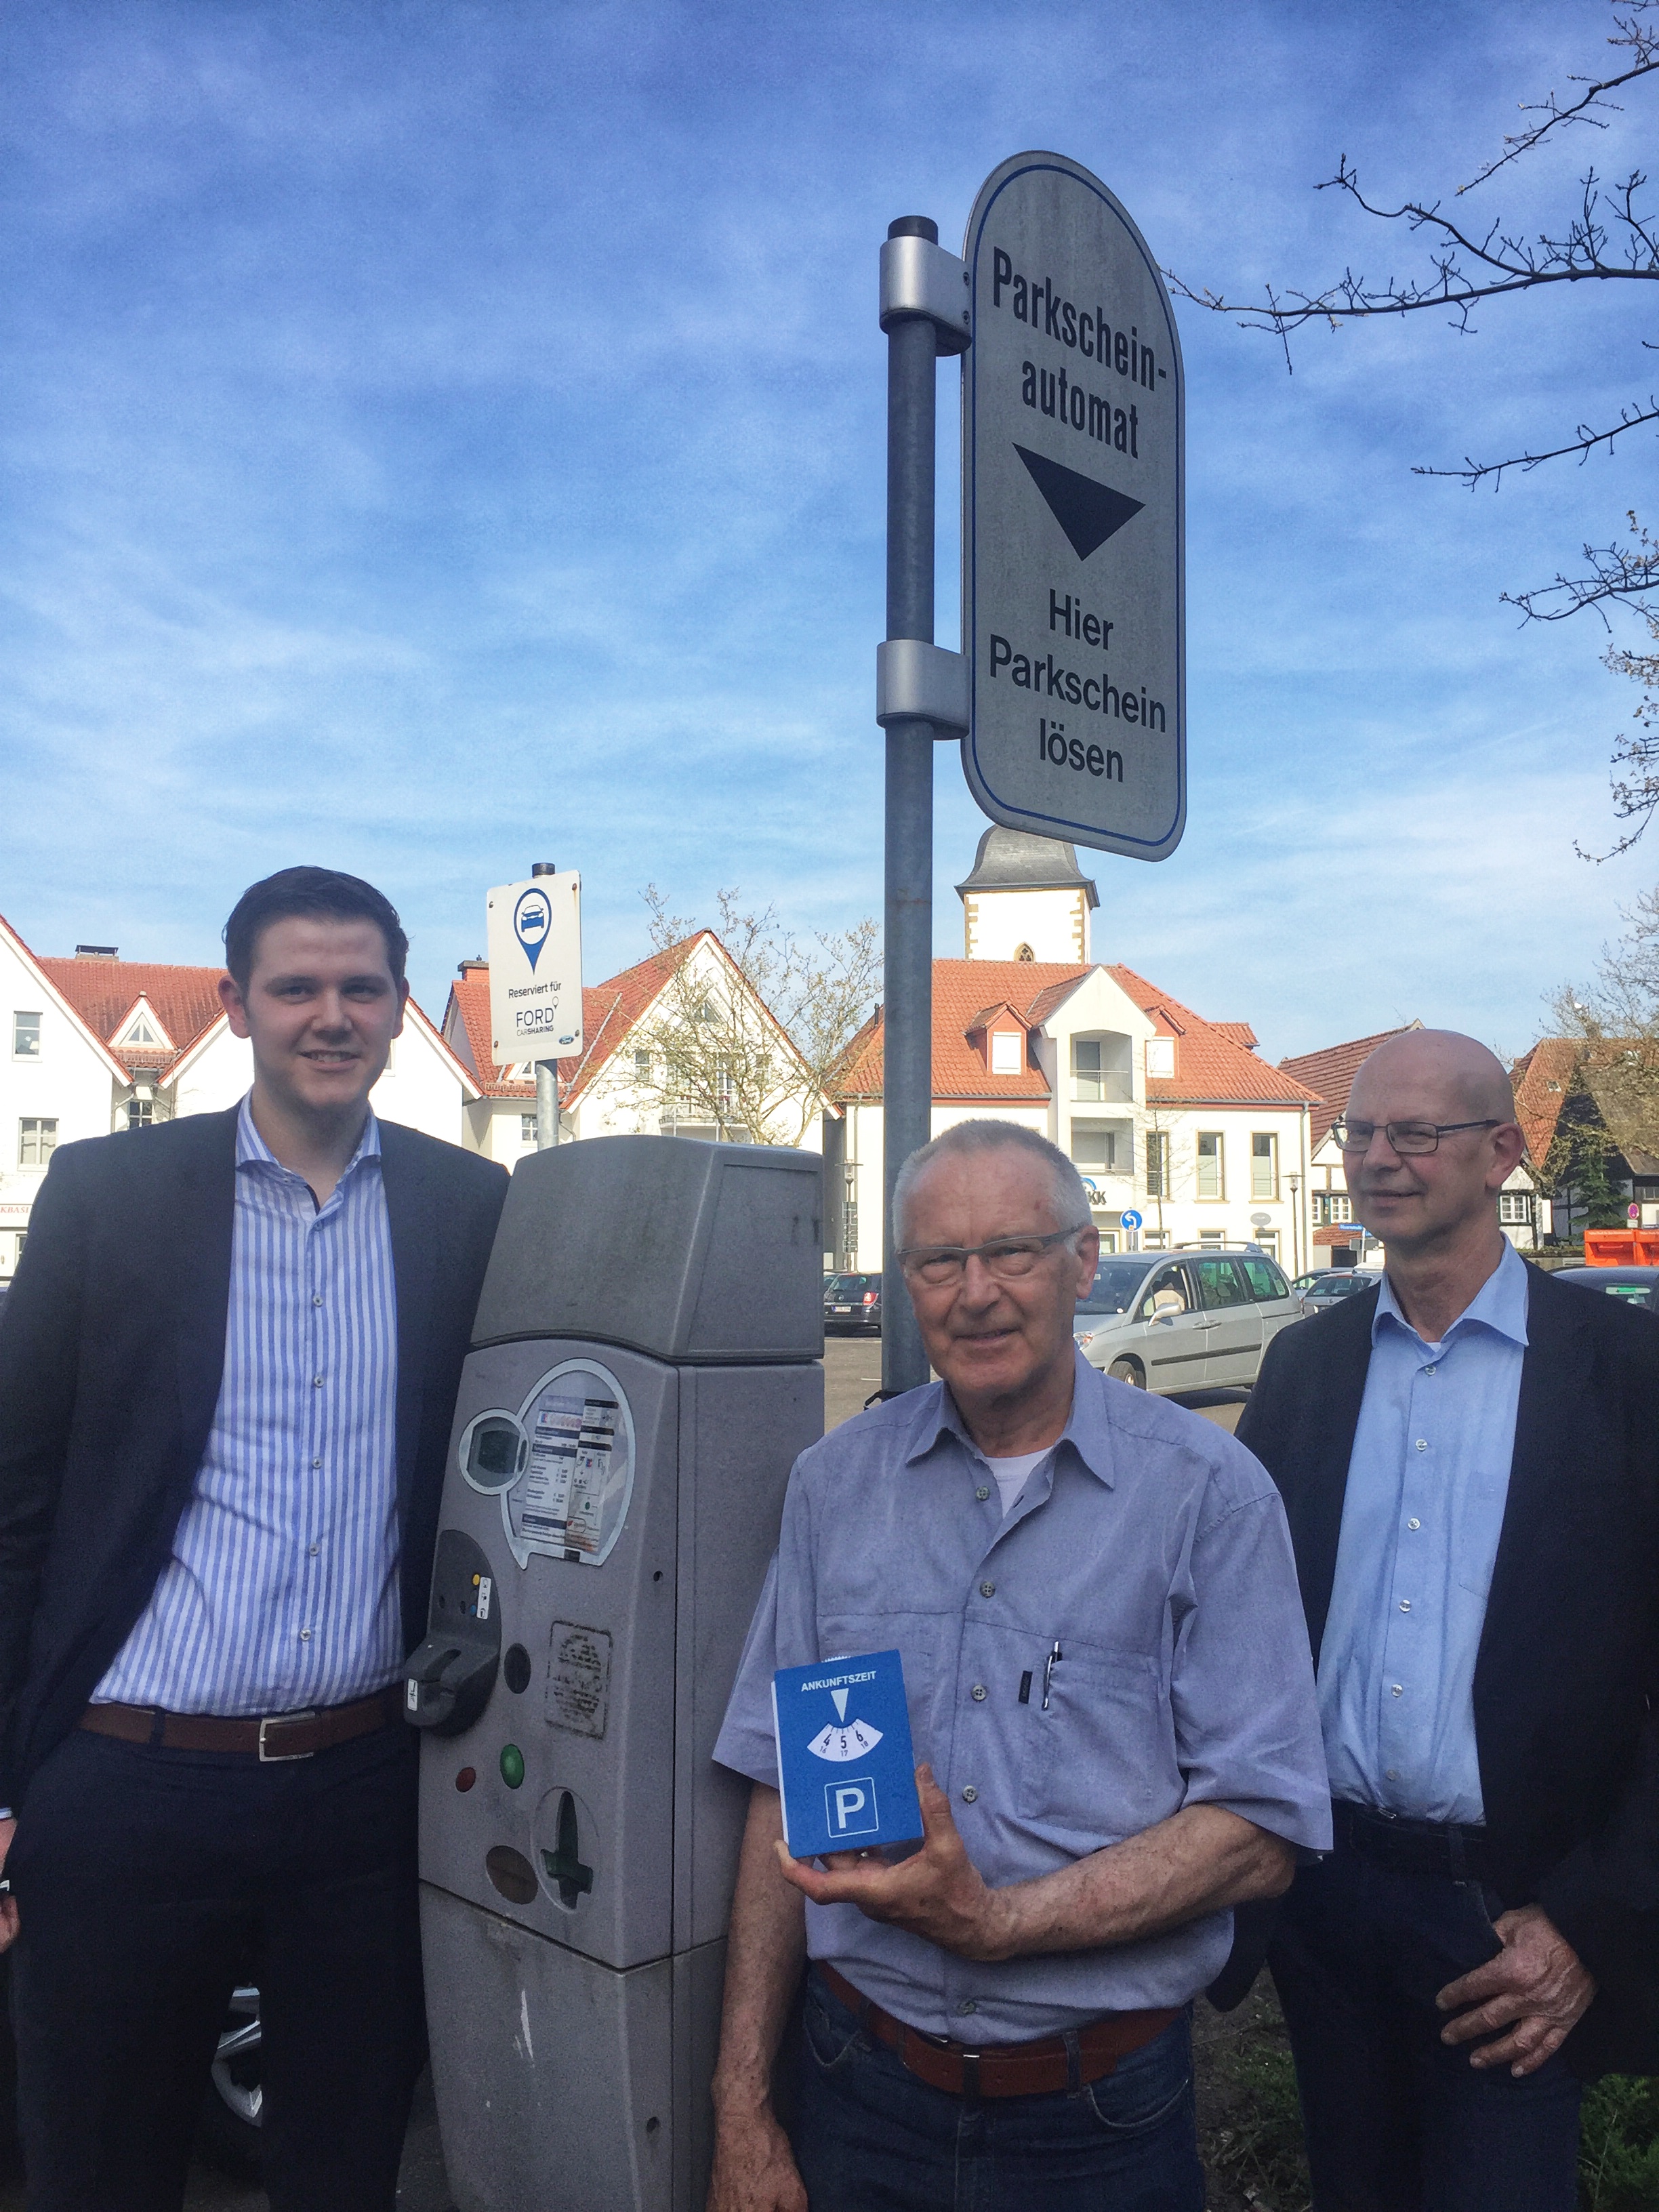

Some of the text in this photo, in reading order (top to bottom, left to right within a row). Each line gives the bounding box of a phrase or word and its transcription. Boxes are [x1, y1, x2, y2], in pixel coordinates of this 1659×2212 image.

[993, 246, 1166, 392] Parkschein-
[1022, 361, 1139, 459] automat
[1049, 588, 1114, 651] Hier
[990, 634, 1166, 733] Parkschein
[1040, 718, 1124, 783] lösen
[508, 981, 561, 999] Reserviert für
[516, 1007, 554, 1028] FORD
[516, 1025, 554, 1037] CARSHARING
[800, 1670, 877, 1692] ANKUNFTSZEIT
[823, 1729, 864, 1749] 4 5 6
[836, 1787, 865, 1830] P
